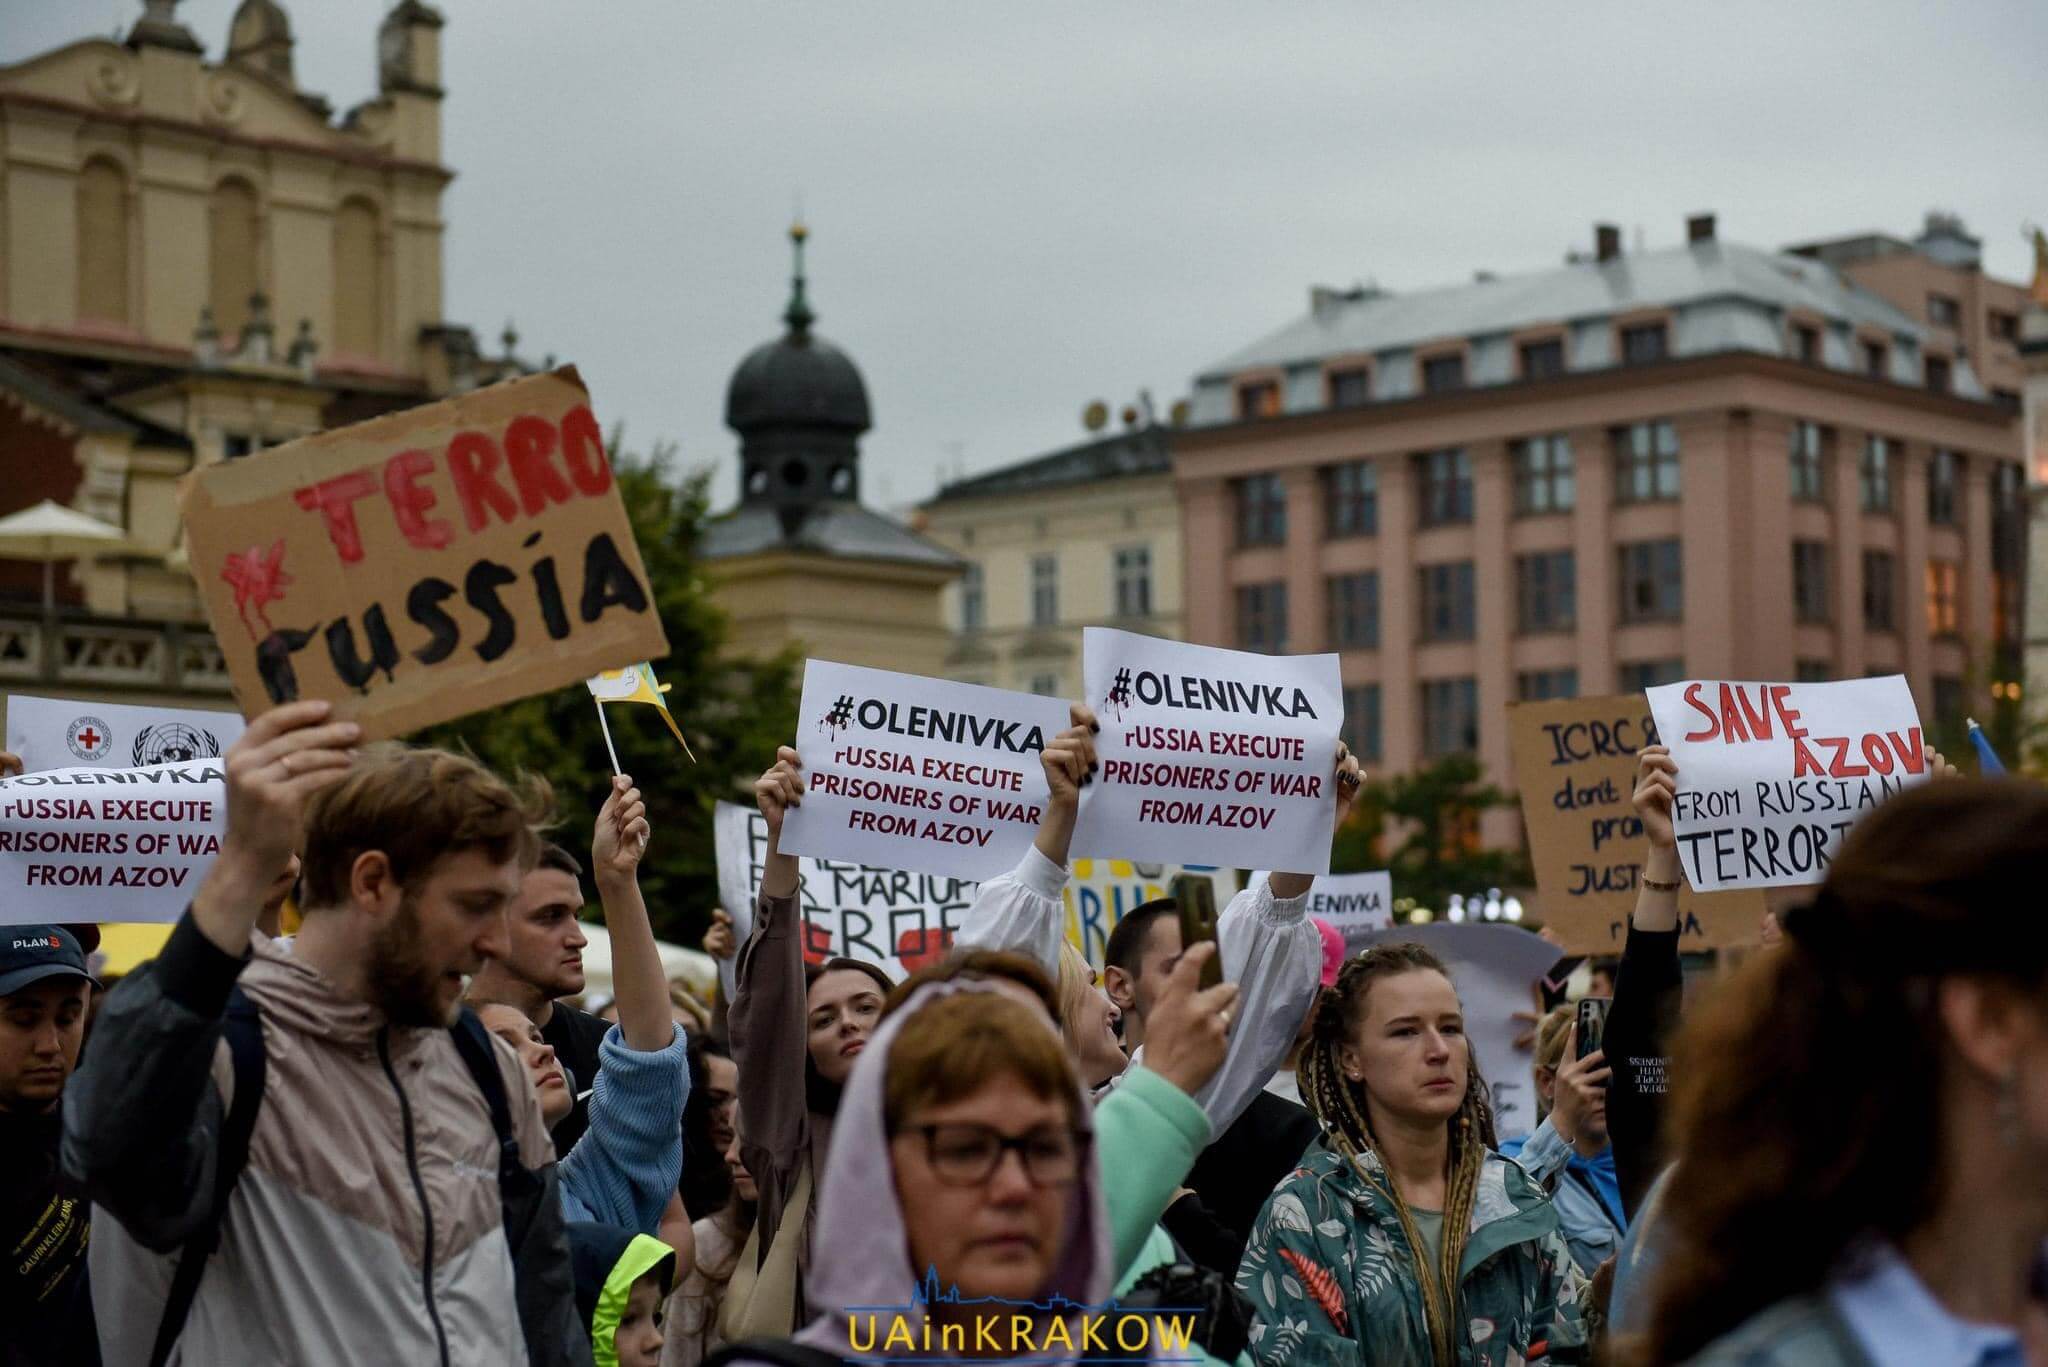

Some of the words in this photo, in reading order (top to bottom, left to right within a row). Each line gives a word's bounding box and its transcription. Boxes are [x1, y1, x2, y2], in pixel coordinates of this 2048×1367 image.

[294, 404, 612, 566] TERRO
[1112, 667, 1318, 720] #OLENIVKA
[1684, 683, 1809, 744] SAVE
[830, 695, 1045, 754] #OLENIVKA
[1125, 726, 1204, 754] rUSSIA
[1210, 732, 1304, 761] EXECUTE
[1542, 717, 1638, 765] ICRC
[834, 746, 916, 775] rUSSIA
[922, 758, 1024, 792] EXECUTE
[1793, 727, 1925, 778] AZOV
[810, 772, 943, 811] PRISONERS
[949, 794, 981, 816] OF
[987, 799, 1042, 826] WAR
[1104, 760, 1231, 791] PRISONERS
[1234, 771, 1266, 794] OF
[1271, 773, 1322, 798] WAR
[5, 798, 95, 820] rUSSIA
[102, 800, 212, 822] EXECUTE
[1139, 800, 1203, 825] FROM
[1206, 805, 1277, 829] AZOV
[1674, 789, 1741, 821] FROM
[0, 831, 128, 855] RISONERS
[135, 833, 170, 855] OF
[177, 834, 220, 856] WA
[848, 810, 917, 837] FROM
[920, 821, 994, 848] AZOV
[27, 865, 102, 887] FROM
[109, 866, 189, 888] AZOV
